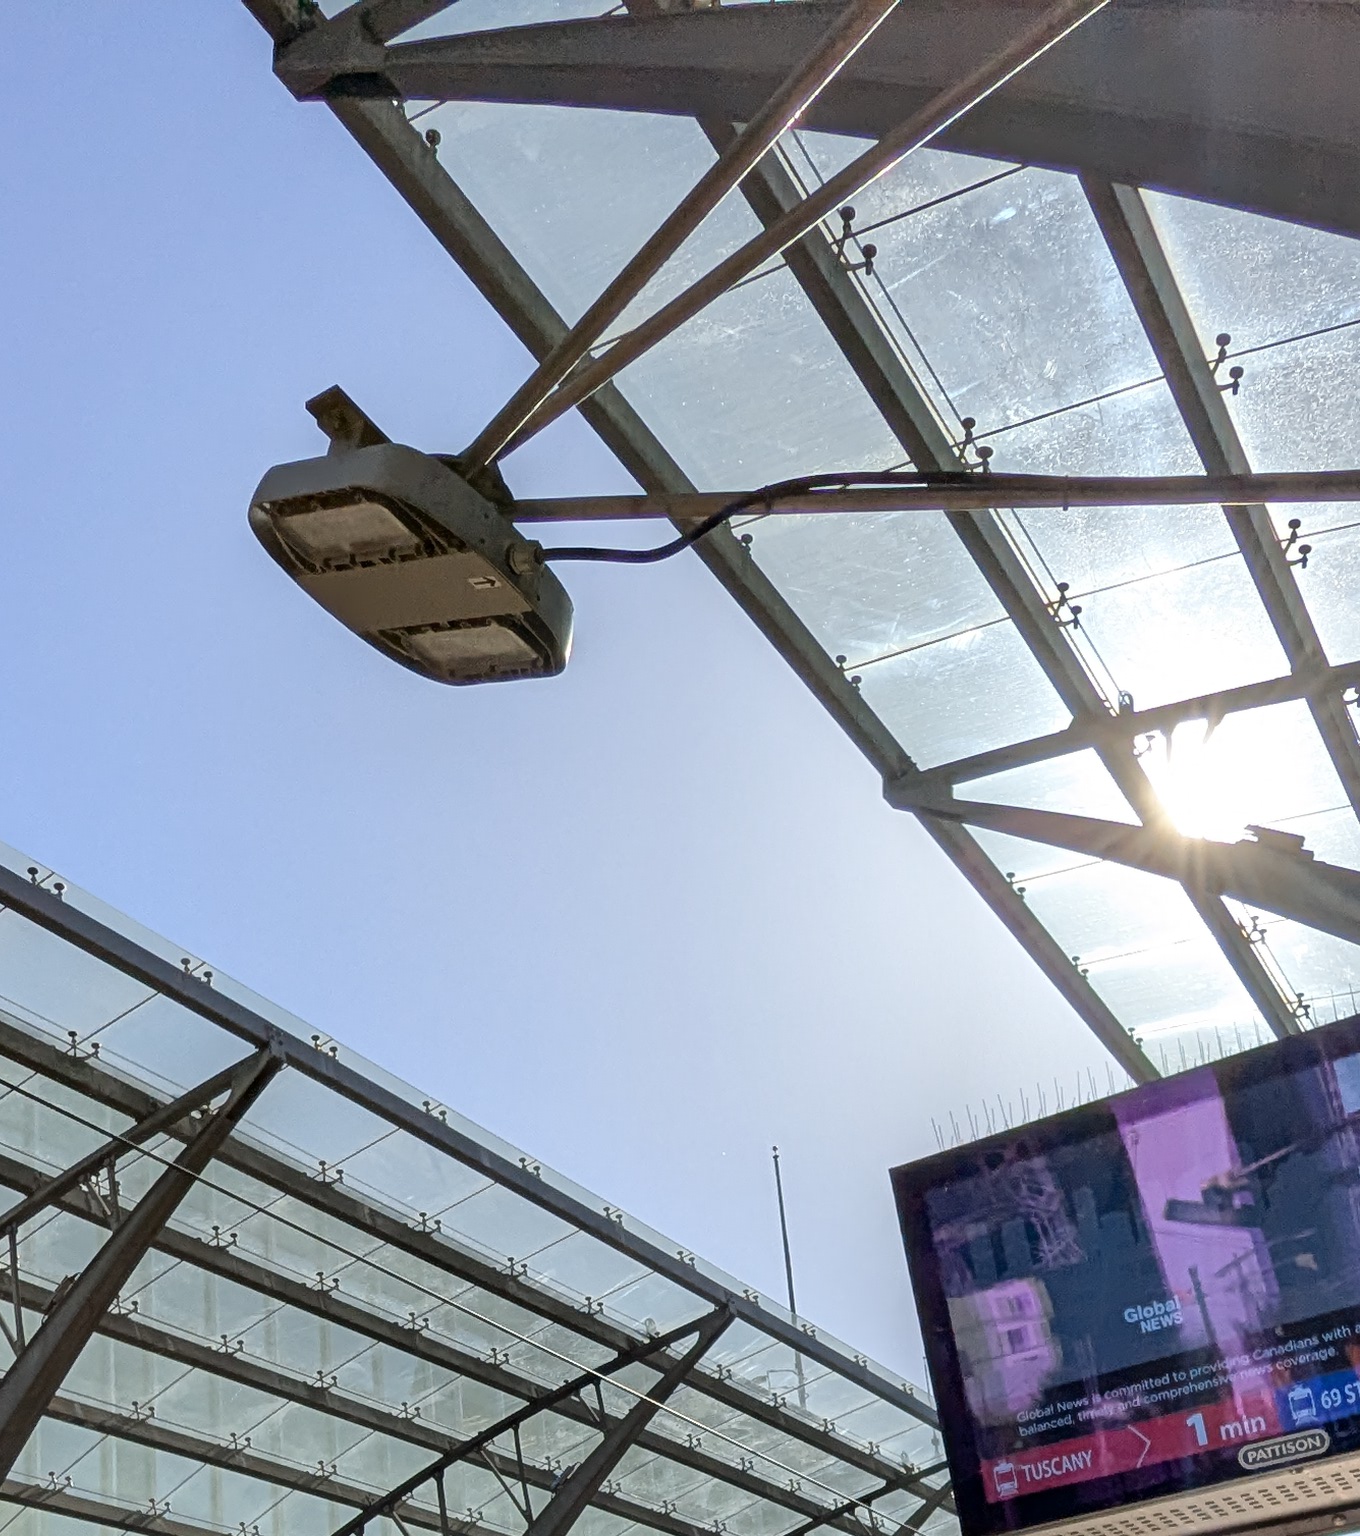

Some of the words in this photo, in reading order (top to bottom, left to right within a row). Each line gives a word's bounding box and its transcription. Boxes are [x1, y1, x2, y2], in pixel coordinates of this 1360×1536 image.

[1124, 1295, 1181, 1324] Global
[1140, 1312, 1183, 1334] NEWS
[1016, 1403, 1055, 1424] Global
[1057, 1395, 1090, 1413] News
[1104, 1373, 1171, 1402] committed
[1172, 1368, 1187, 1383] to
[1189, 1354, 1250, 1381] providing
[1252, 1335, 1320, 1361] Canadians
[1321, 1323, 1352, 1343] with
[1320, 1388, 1342, 1410] 69
[1018, 1416, 1076, 1438] balanced,
[1186, 1413, 1209, 1447] 1
[1219, 1413, 1267, 1441] min
[1246, 1433, 1322, 1464] PATTISON
[1021, 1450, 1093, 1483] TUSCANY
